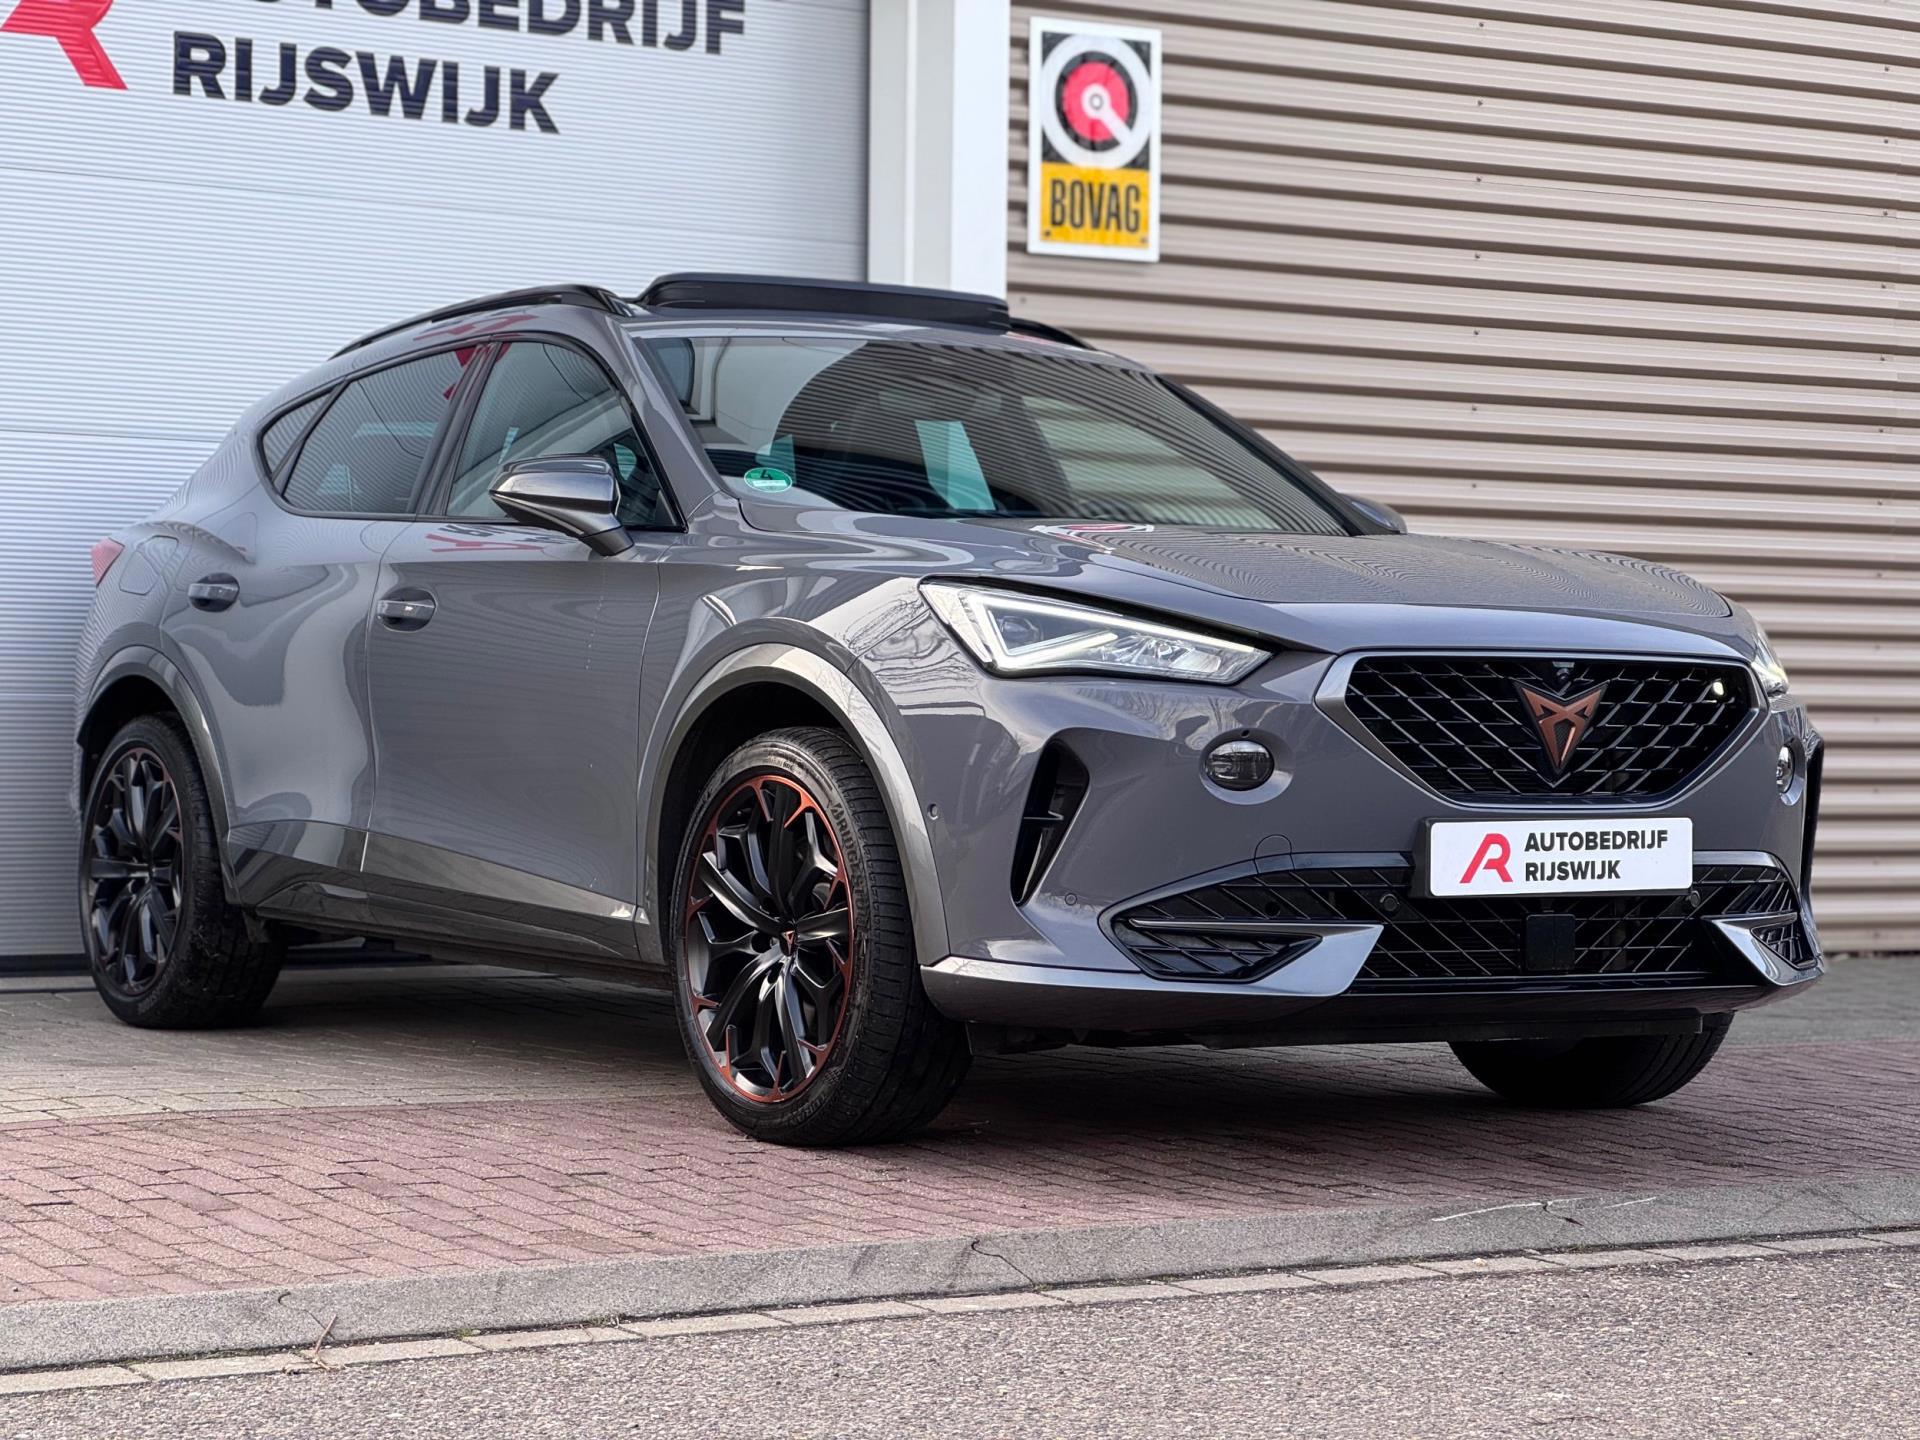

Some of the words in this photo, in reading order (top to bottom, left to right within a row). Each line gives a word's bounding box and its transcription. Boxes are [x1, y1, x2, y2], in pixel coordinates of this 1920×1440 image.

[256, 0, 745, 55] DRIJF
[173, 30, 560, 135] RIJSWIJK
[1050, 178, 1140, 234] BOVAG
[1524, 829, 1669, 852] AUTOBEDRIJF
[1524, 860, 1621, 882] RIJSWIJK
